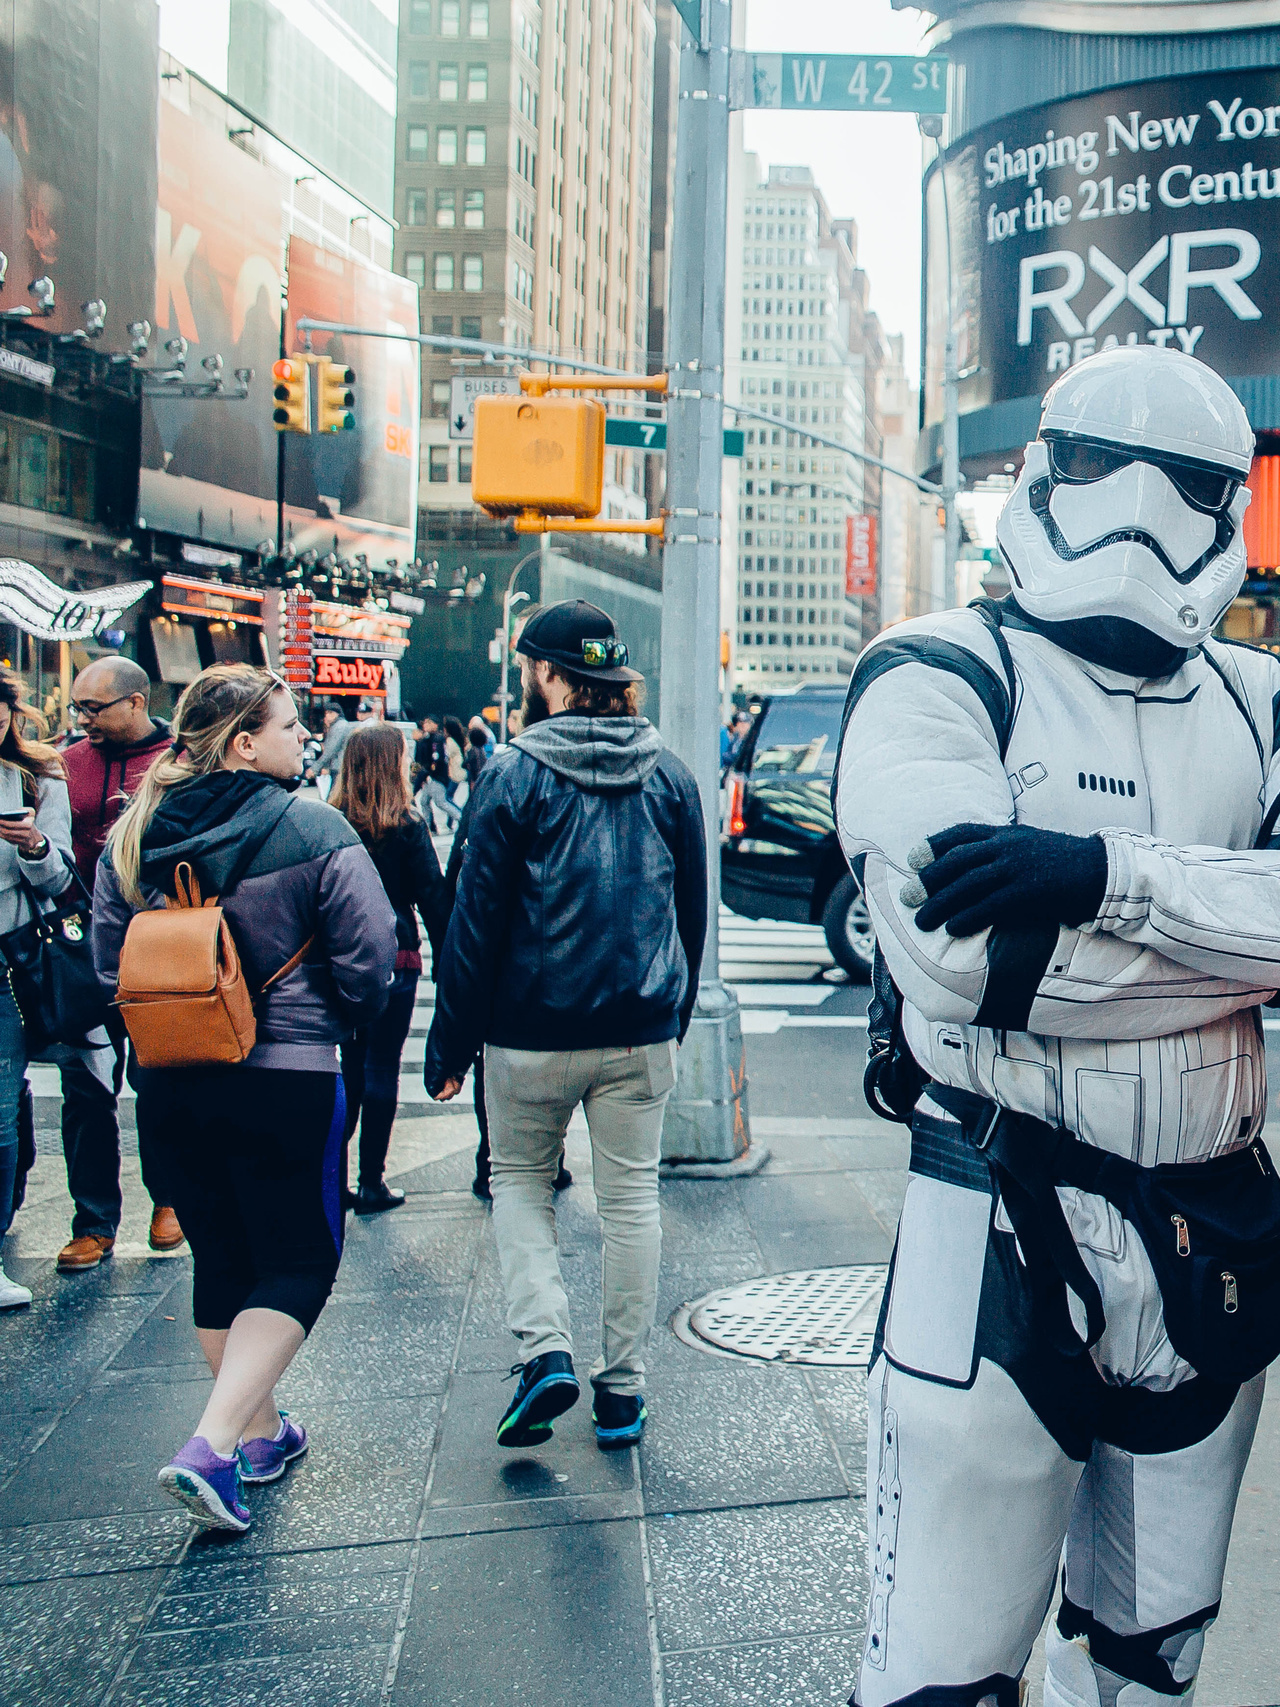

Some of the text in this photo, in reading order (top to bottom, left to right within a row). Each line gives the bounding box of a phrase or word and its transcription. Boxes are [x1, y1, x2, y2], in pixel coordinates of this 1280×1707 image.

[792, 59, 940, 104] W 42 St
[983, 129, 1100, 189] Shaping
[1104, 110, 1201, 158] New
[986, 202, 1019, 245] for
[1024, 186, 1073, 233] the
[1077, 174, 1152, 222] 21st
[1016, 227, 1263, 347] RXR
[464, 380, 508, 393] BUSES
[639, 424, 656, 446] 7
[315, 656, 384, 690] Ruby
